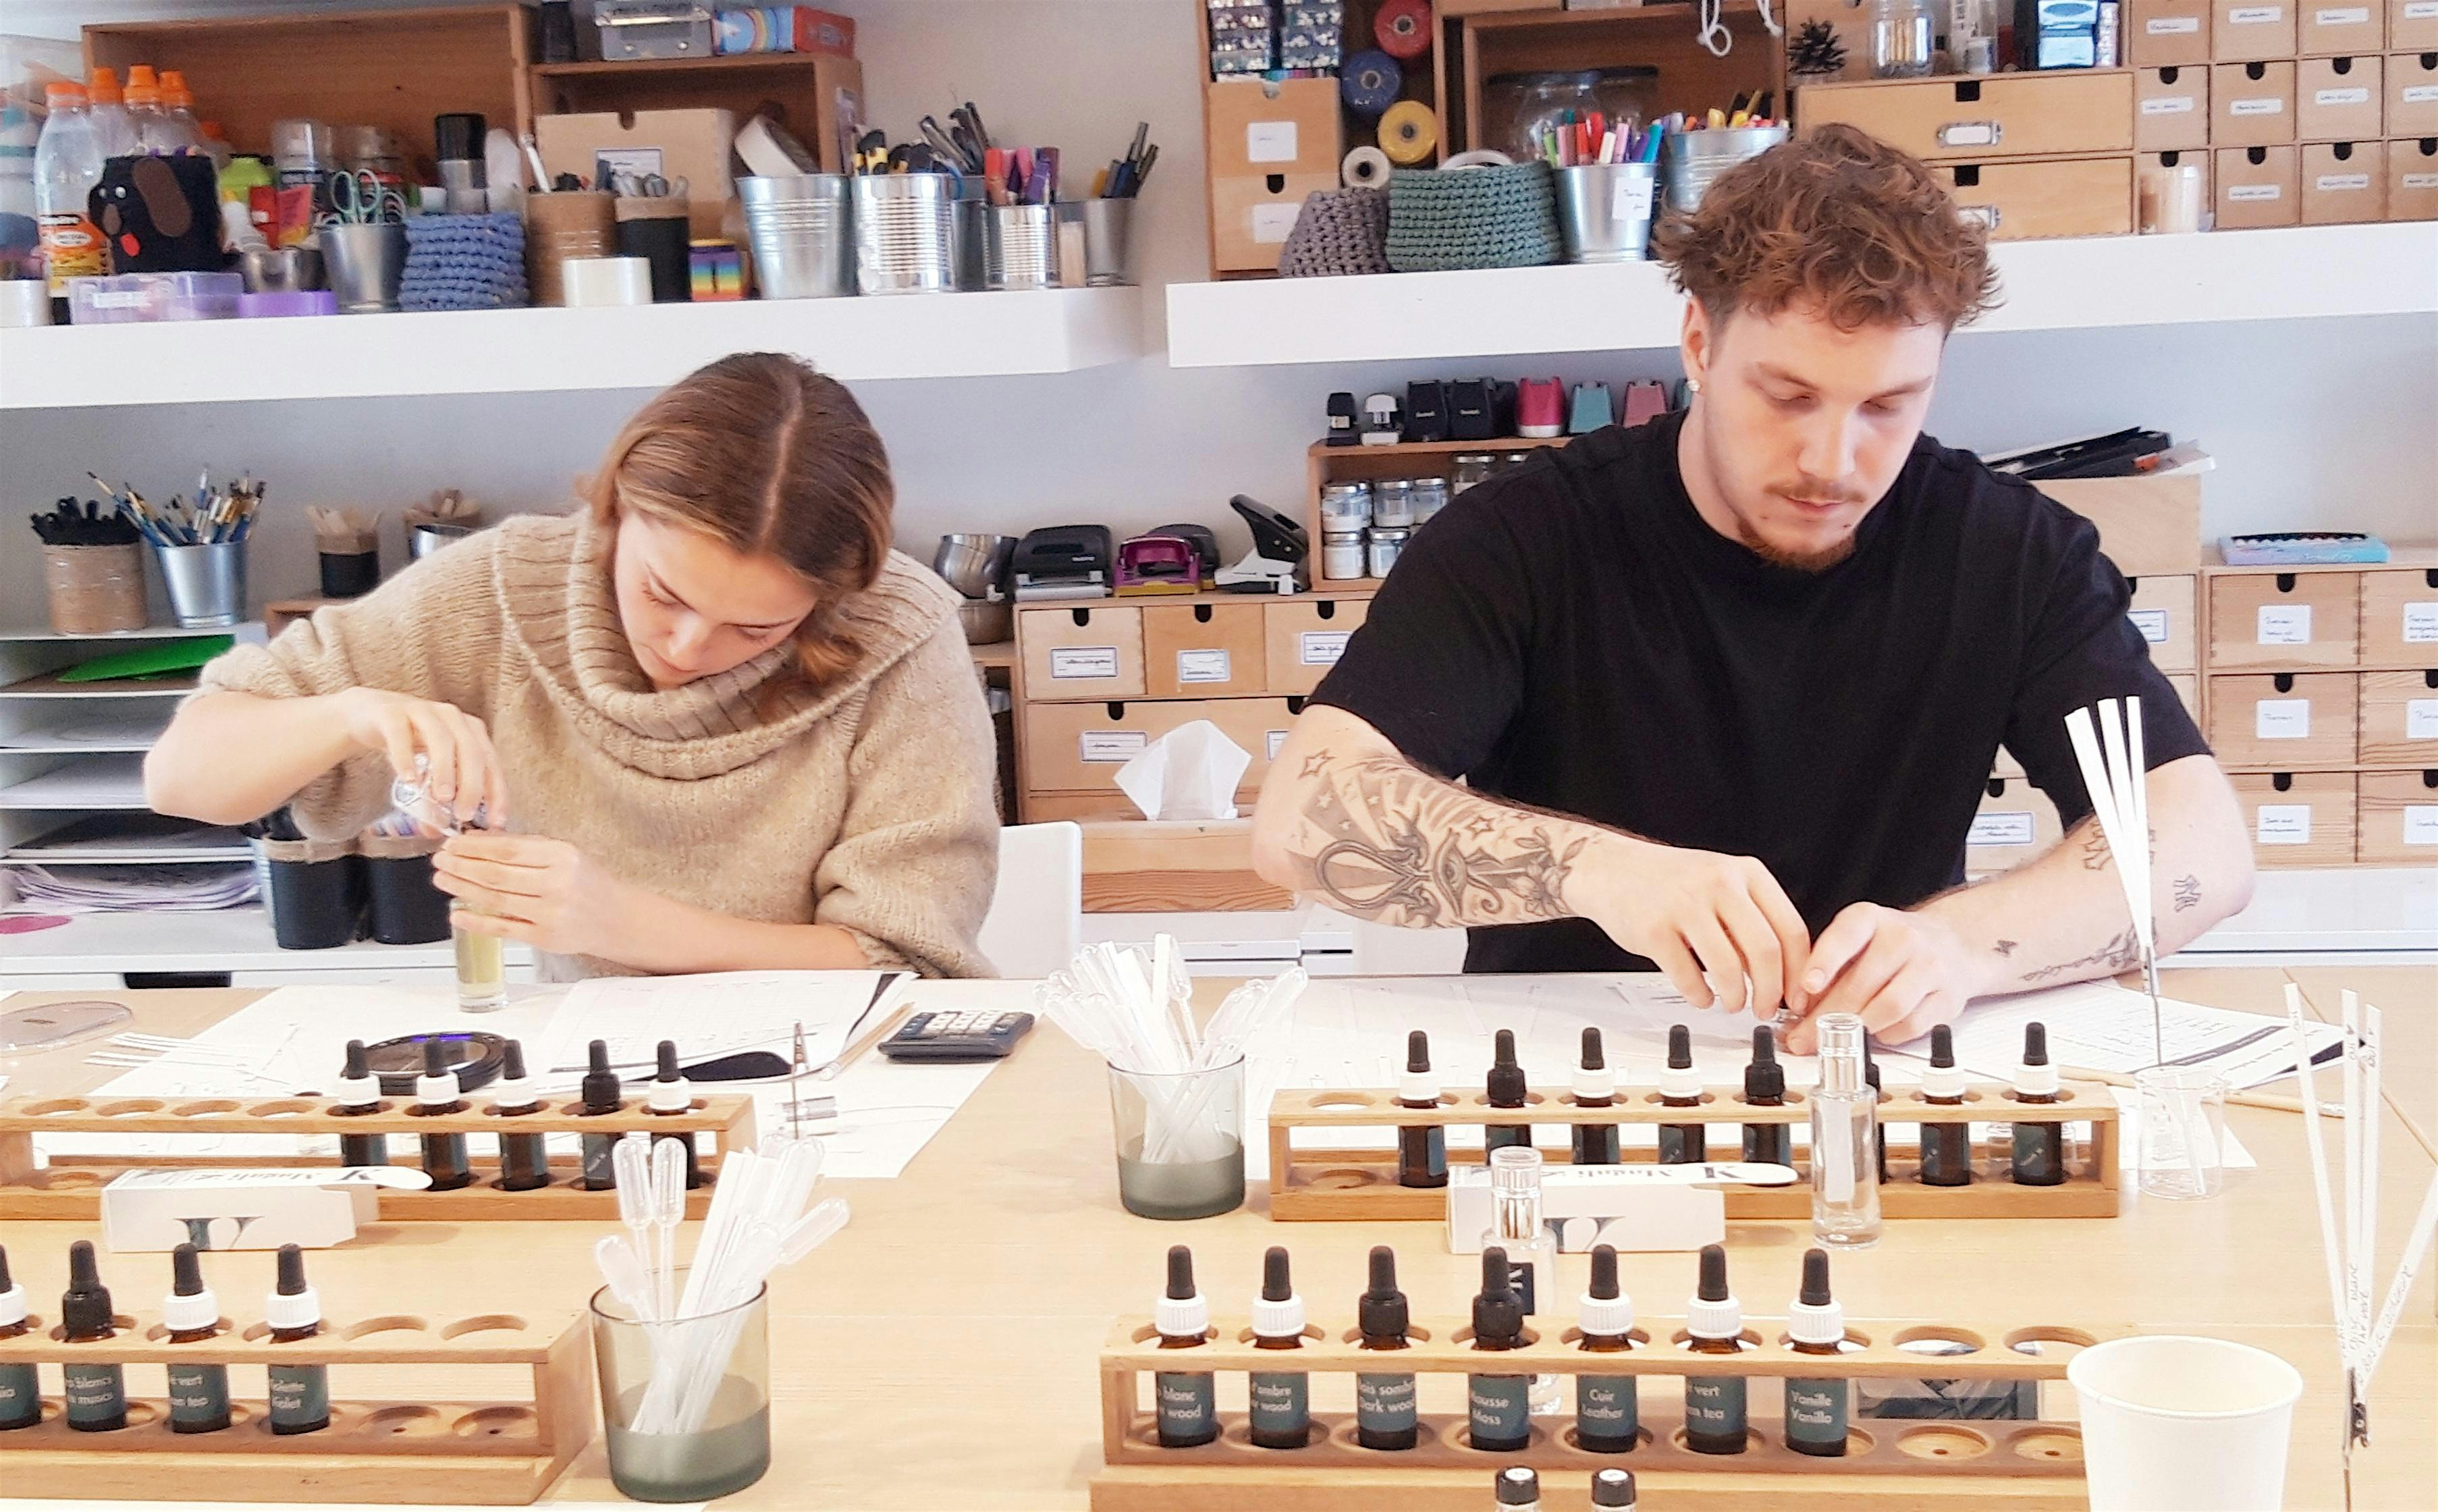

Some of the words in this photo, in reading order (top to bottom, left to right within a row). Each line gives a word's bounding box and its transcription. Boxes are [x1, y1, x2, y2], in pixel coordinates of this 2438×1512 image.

[1163, 1386, 1196, 1402] blanc
[1589, 1388, 1615, 1403] Cuir
[1694, 1385, 1721, 1397] vert
[1791, 1390, 1833, 1407] Vanille
[1166, 1403, 1202, 1419] wood
[1262, 1399, 1292, 1412] wood
[1581, 1403, 1625, 1420] Leather
[1702, 1408, 1725, 1420] tea
[1791, 1406, 1833, 1424] Vanilla
